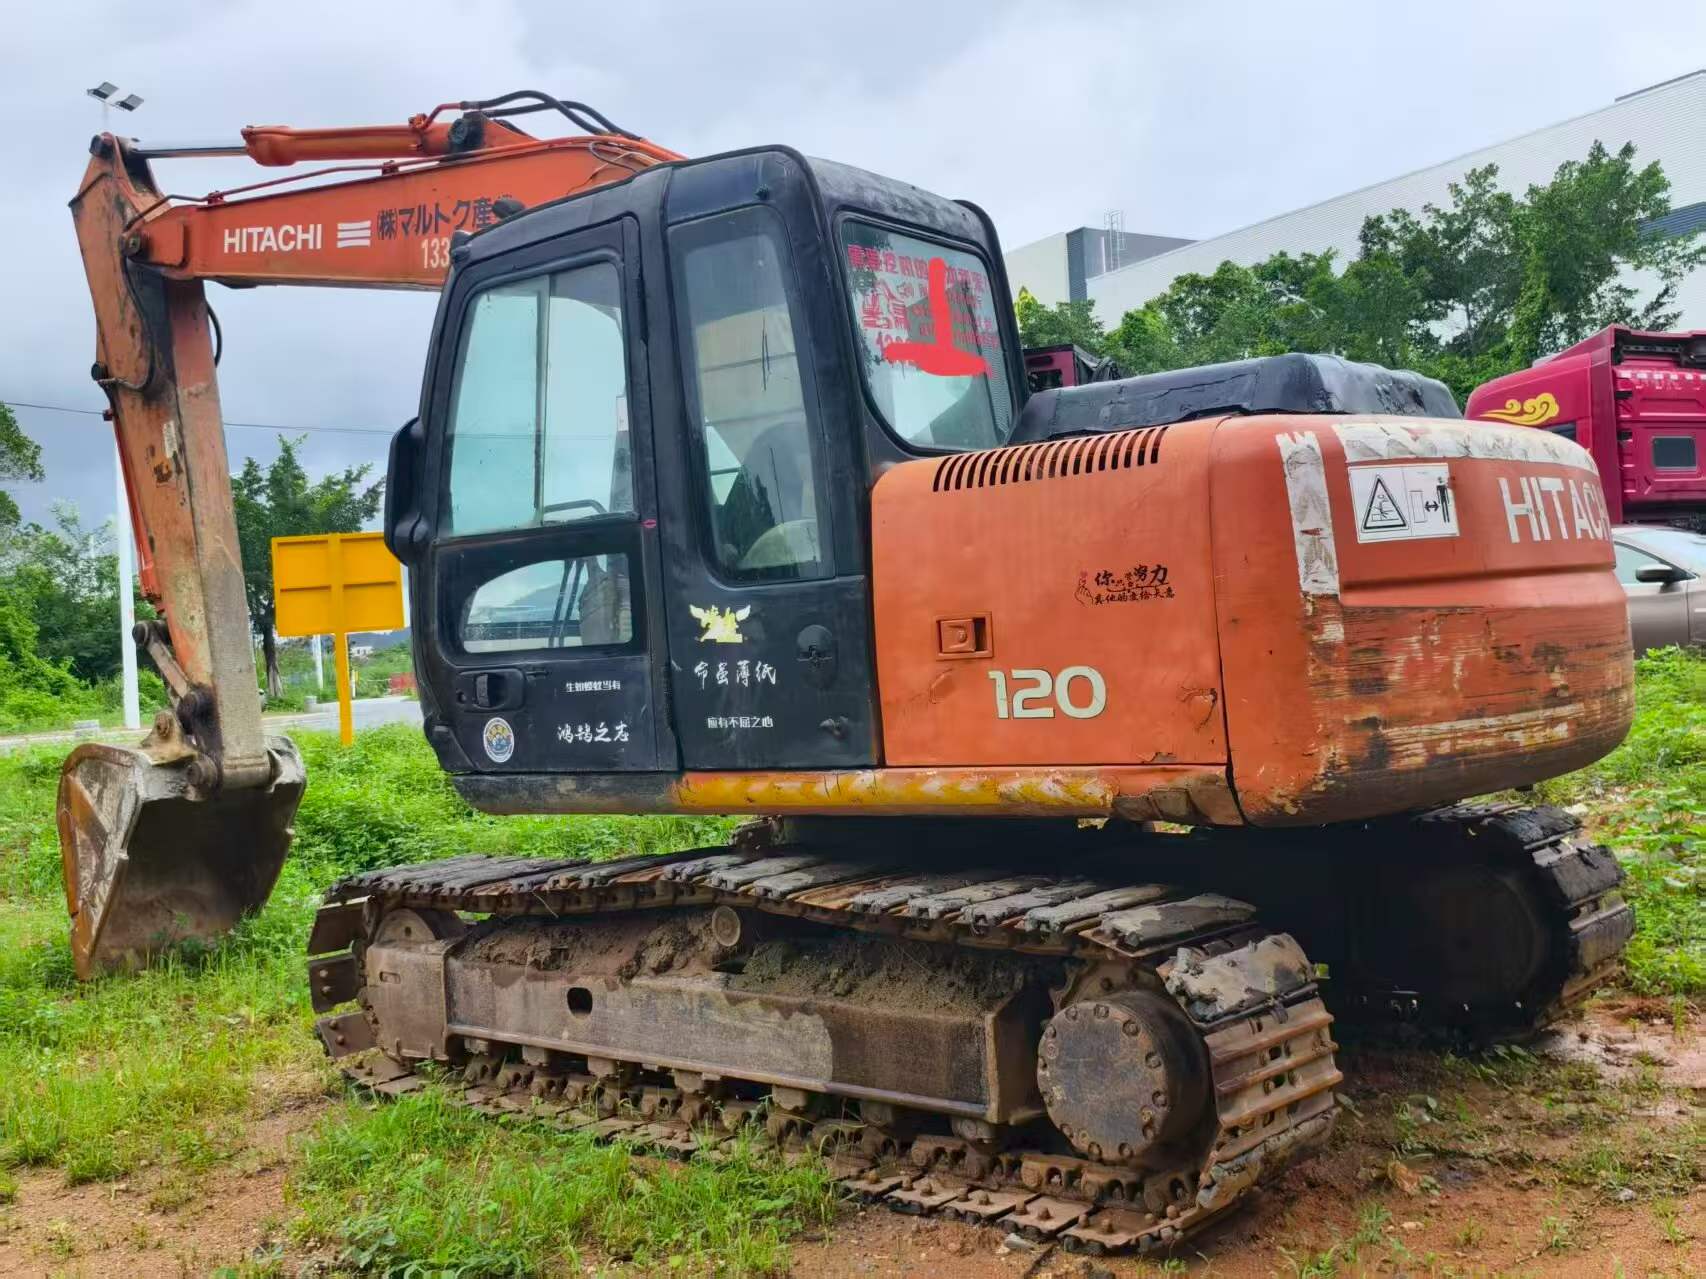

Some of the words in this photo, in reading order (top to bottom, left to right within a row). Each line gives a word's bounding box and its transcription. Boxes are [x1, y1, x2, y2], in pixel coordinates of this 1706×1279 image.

[377, 194, 512, 240] (株)マルトク産
[223, 223, 323, 254] HITACHI
[1499, 476, 1610, 544] HITACH
[987, 665, 1107, 719] 120
[557, 721, 630, 744] 鸿鹄之志
[707, 716, 774, 729] 应有不屈之心
